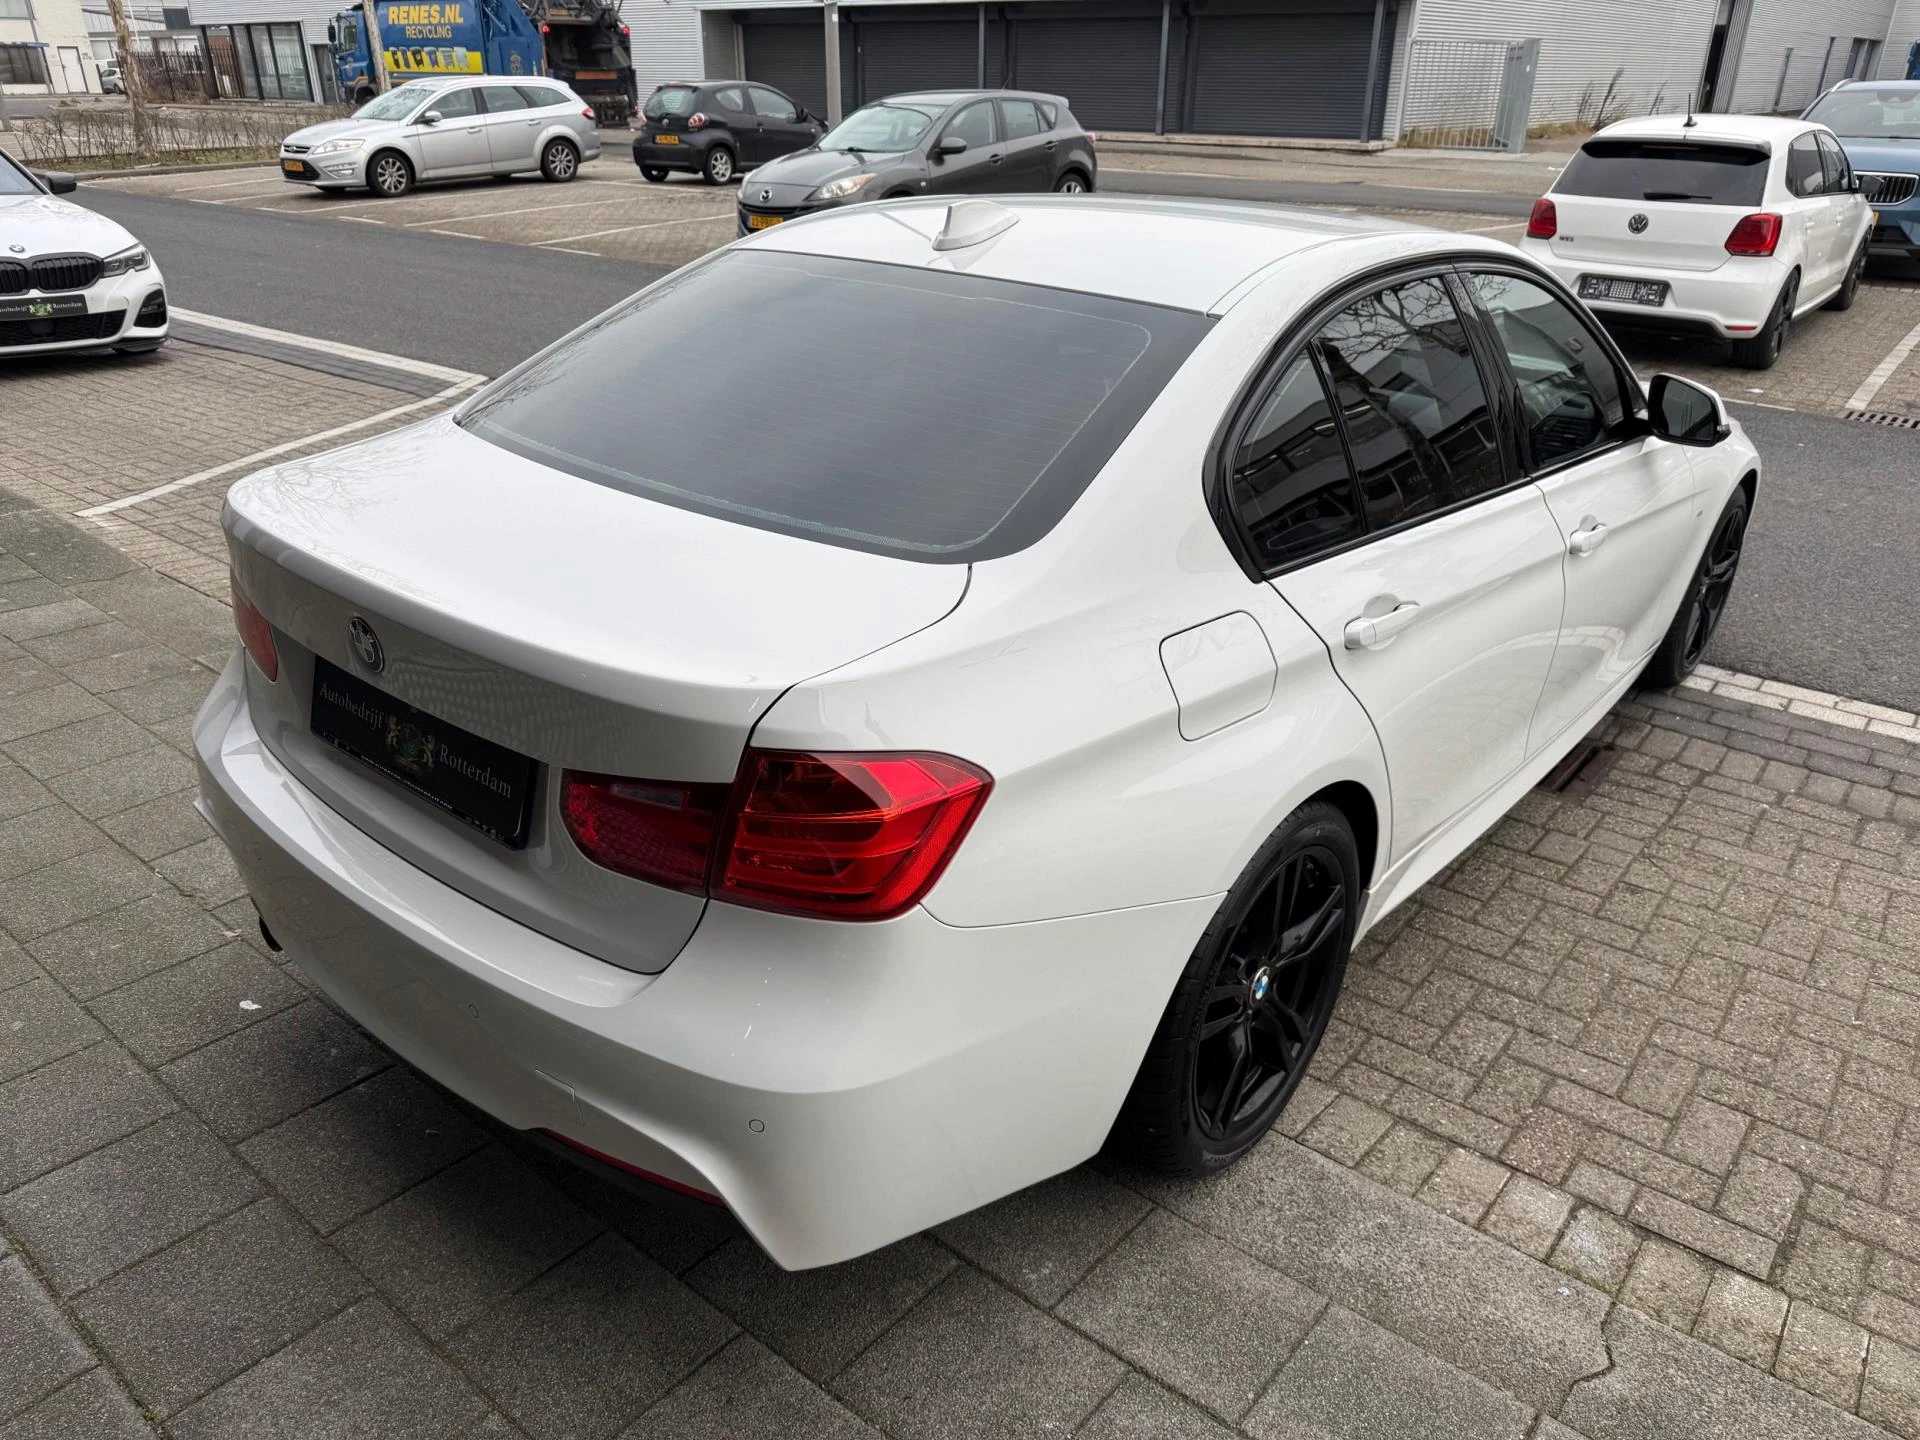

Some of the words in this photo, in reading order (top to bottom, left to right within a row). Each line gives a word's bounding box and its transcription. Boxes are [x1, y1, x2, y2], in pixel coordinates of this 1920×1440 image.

[388, 3, 464, 24] RENES.NL
[406, 25, 451, 39] RECYCLING
[319, 682, 385, 730] Autobedrijf
[439, 743, 513, 798] Rotterdam
